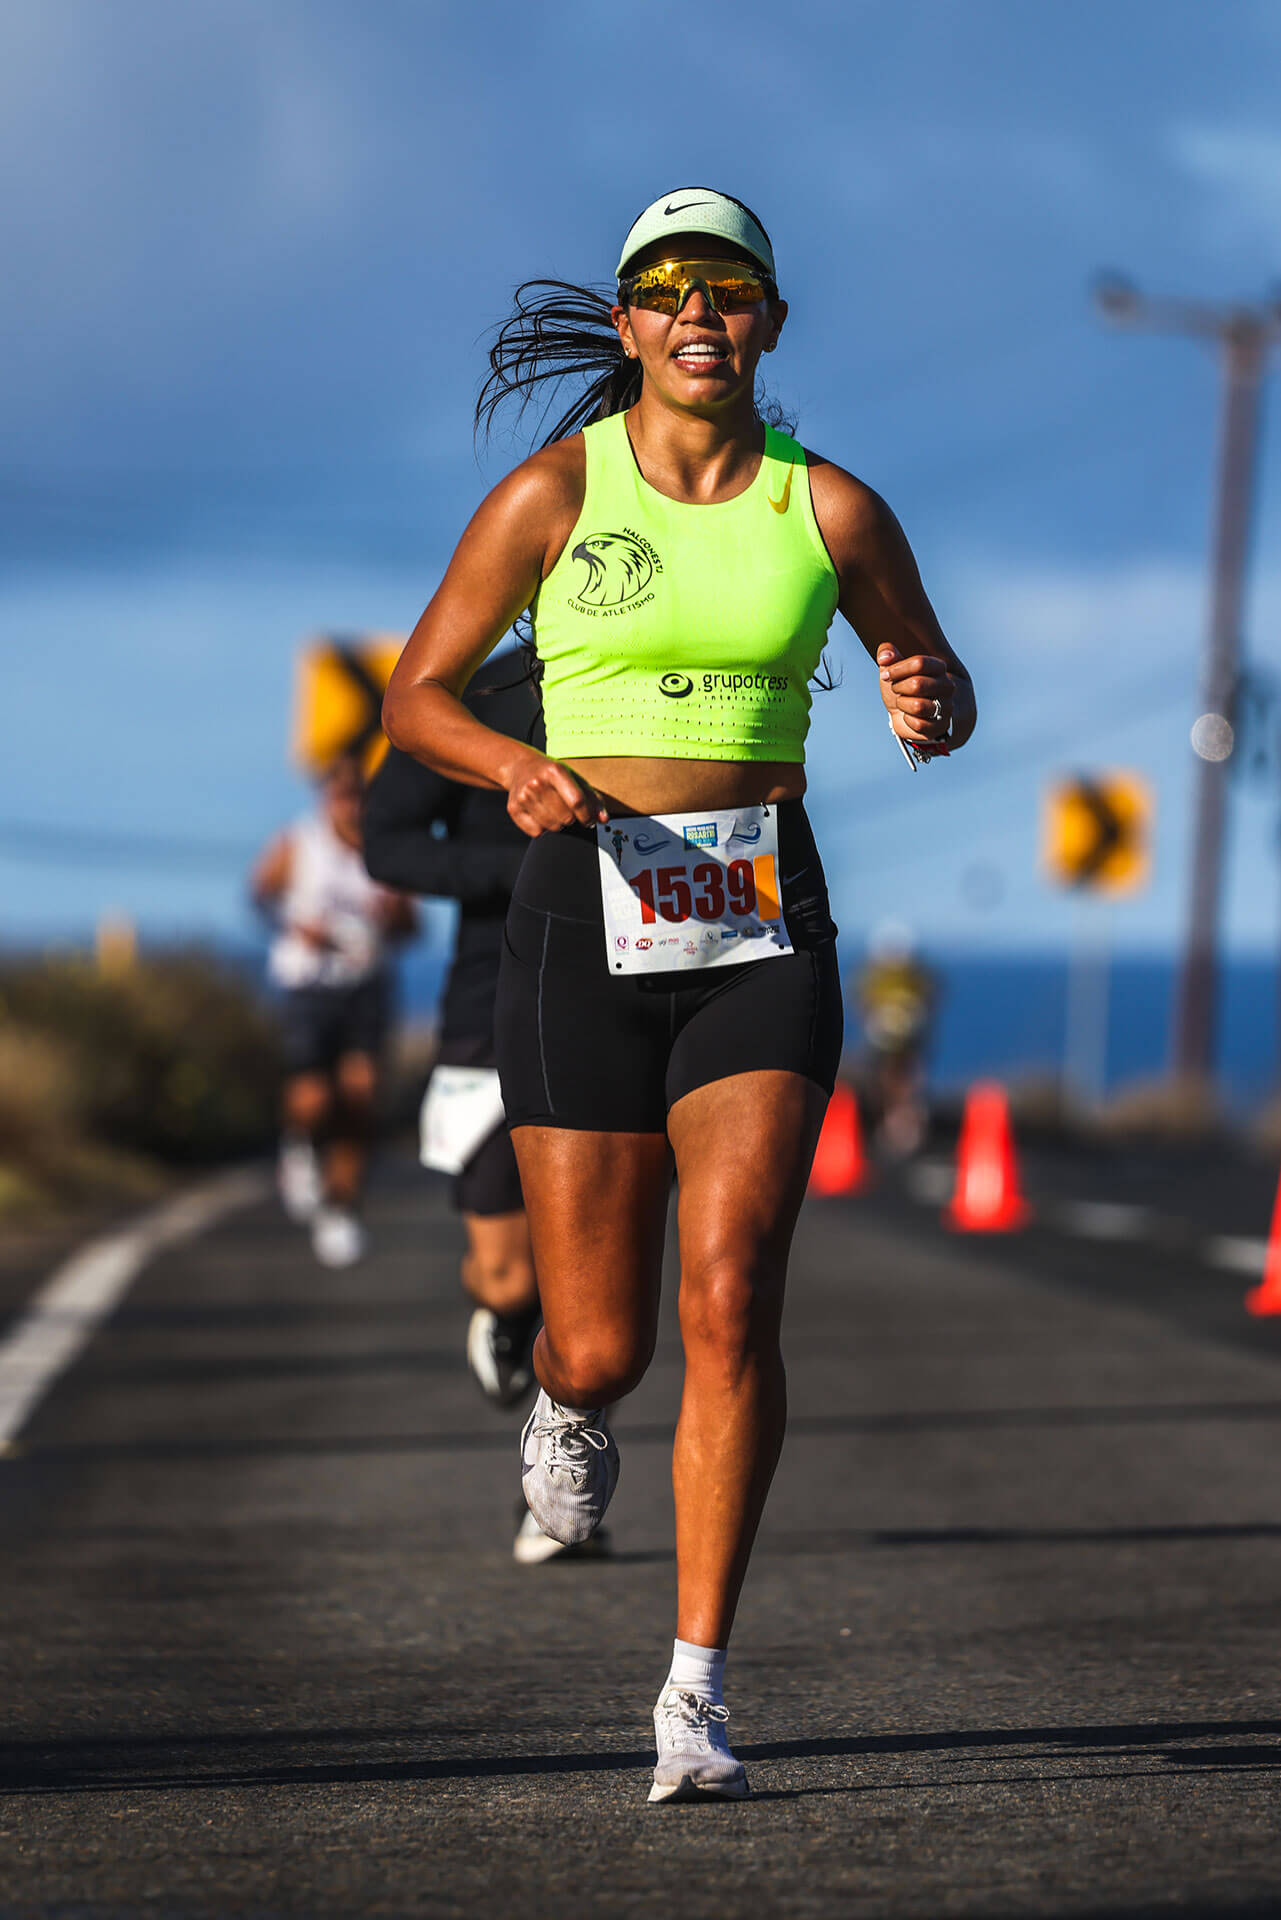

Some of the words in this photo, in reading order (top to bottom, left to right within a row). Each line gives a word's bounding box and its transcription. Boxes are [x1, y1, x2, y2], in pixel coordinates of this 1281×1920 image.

[567, 598, 586, 614] CLUB
[587, 608, 598, 617] DE
[602, 592, 655, 617] ATLETISMO
[703, 673, 788, 692] grupotress
[629, 859, 756, 925] 1539
